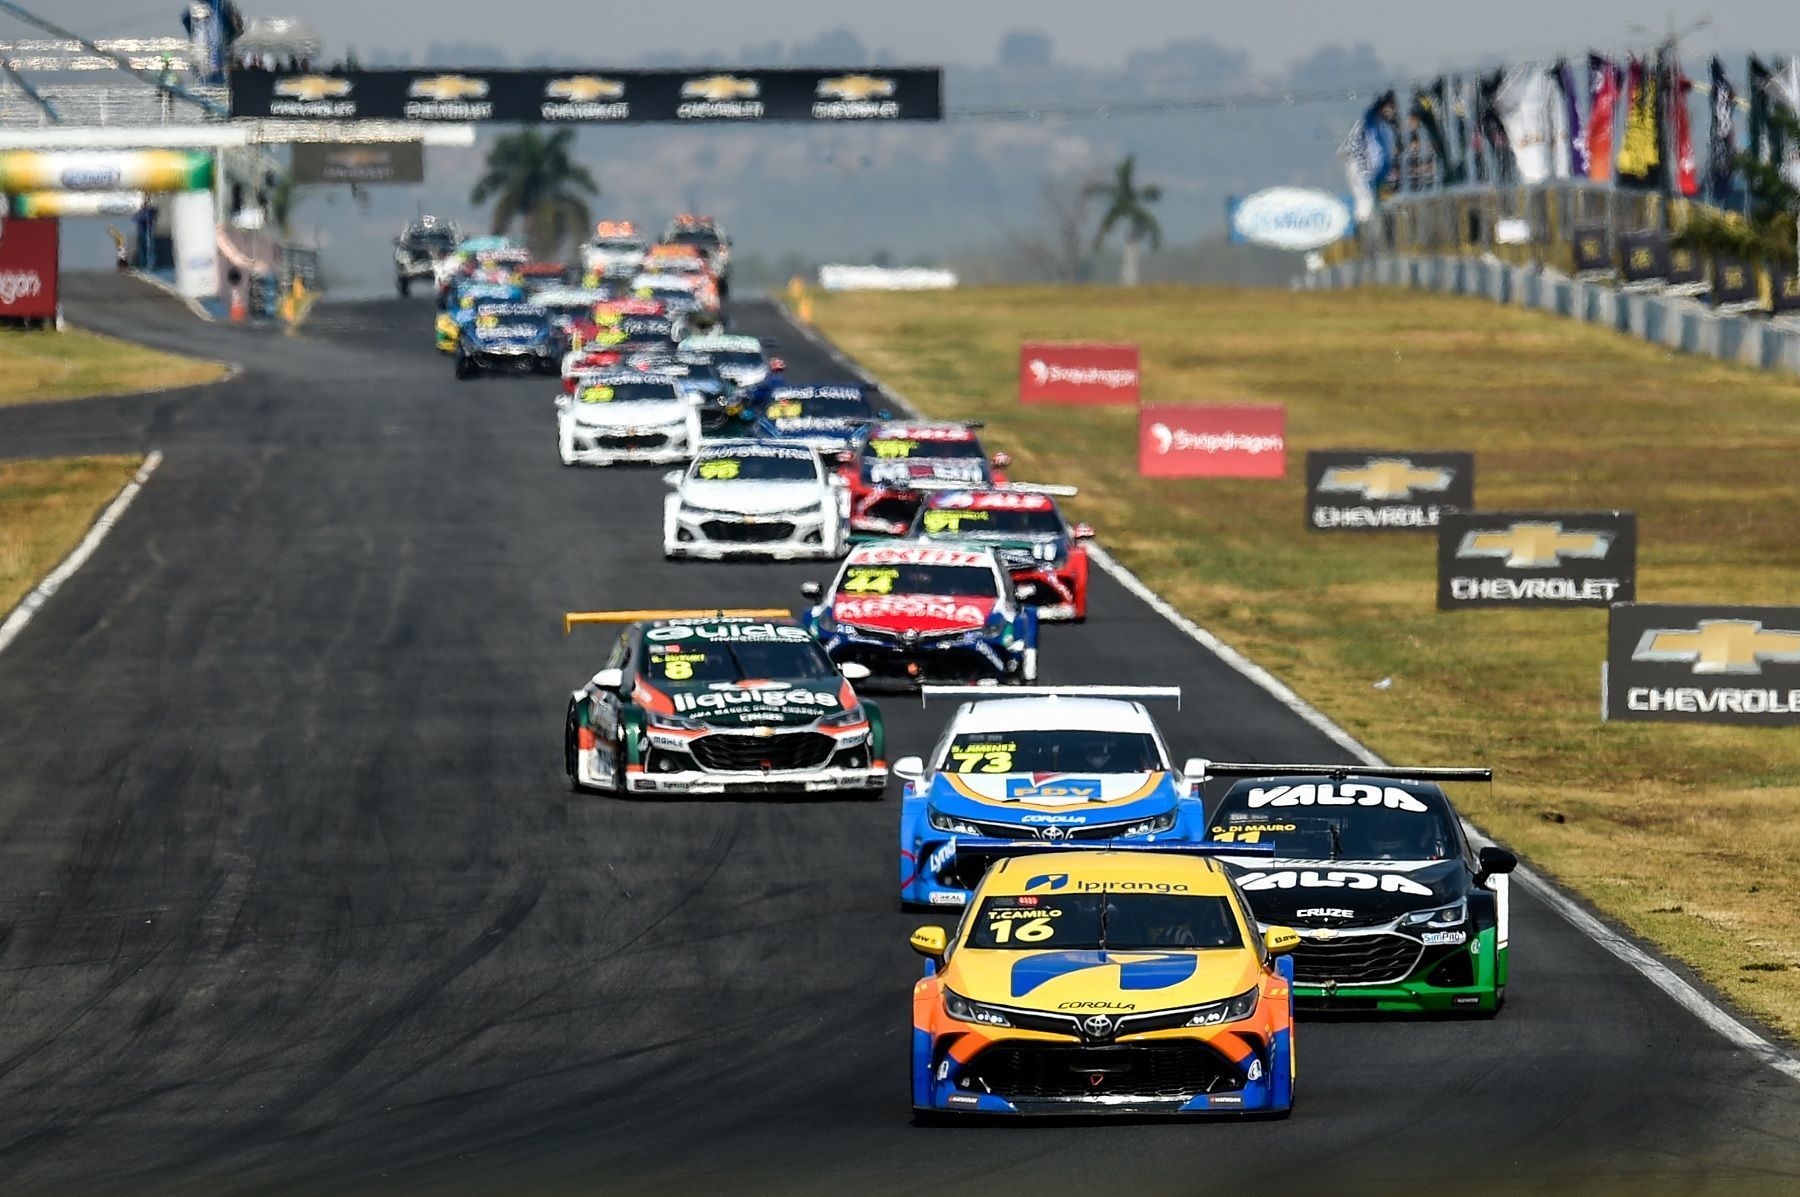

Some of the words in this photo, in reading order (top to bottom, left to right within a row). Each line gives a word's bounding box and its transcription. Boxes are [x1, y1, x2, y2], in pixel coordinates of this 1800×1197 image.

[1174, 428, 1284, 454] Snapdragon
[1449, 577, 1620, 601] CHEVROLET
[664, 661, 694, 680] 8
[953, 752, 1013, 773] 73
[1013, 788, 1094, 797] PDV
[1248, 784, 1428, 812] VALDA
[1021, 815, 1087, 824] COROLLA
[1245, 824, 1296, 832] MAURO
[1077, 880, 1189, 893] Ipiranga
[1296, 908, 1354, 918] CRUZE
[990, 918, 1055, 943] 16
[1274, 933, 1298, 945] Baw
[1058, 1002, 1136, 1011] COROLLA
